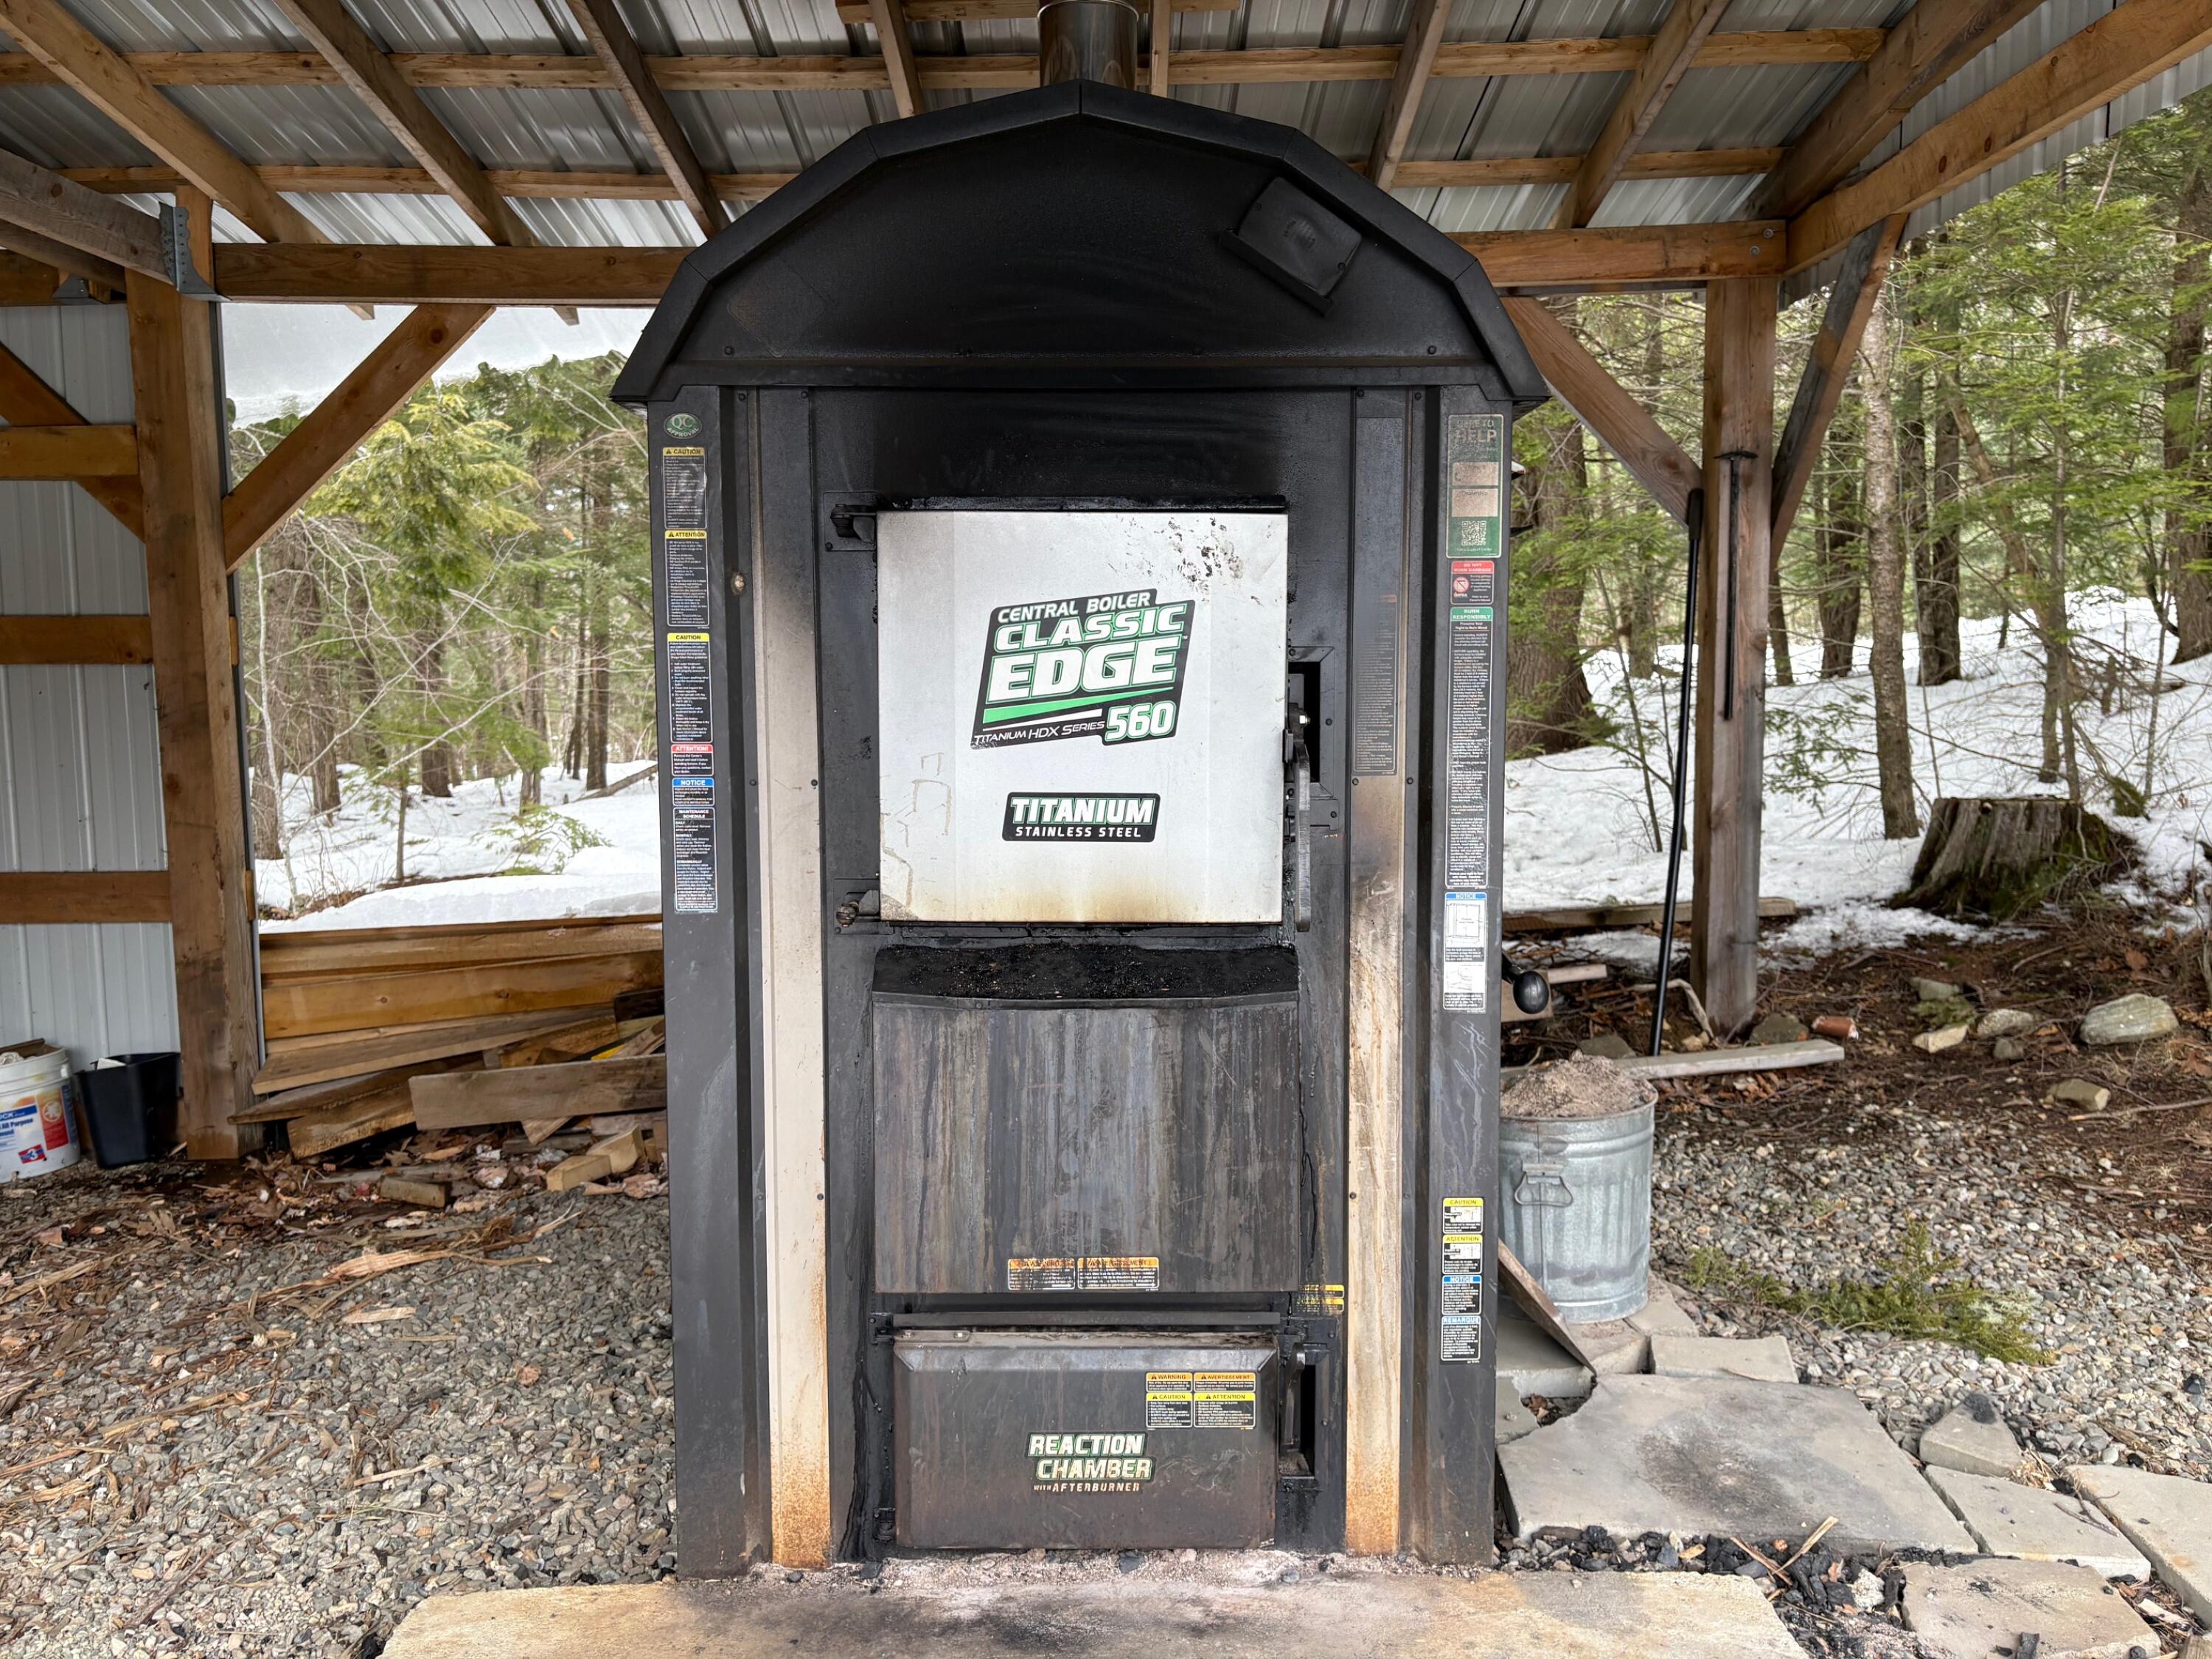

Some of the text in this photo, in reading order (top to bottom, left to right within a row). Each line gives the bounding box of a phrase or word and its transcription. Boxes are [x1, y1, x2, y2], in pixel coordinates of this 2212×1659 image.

[667, 428, 699, 437] APPROVAL
[672, 416, 693, 430] QC
[998, 591, 1151, 624] CENTRAL BOILER
[994, 603, 1187, 651] CLASSIC
[987, 634, 1183, 705] EDGE
[1105, 700, 1178, 743] 560
[973, 729, 1027, 745] TITANIUM
[1029, 725, 1060, 740] HDX
[1010, 796, 1156, 826] TITANIUM
[1015, 826, 1141, 838] STAINLESS STEEL
[10, 1118, 33, 1127] Purpose
[1028, 1433, 1146, 1458] REACTION
[1036, 1457, 1154, 1481] CHAMBER
[1051, 1483, 1141, 1493] AFTERBURNER
